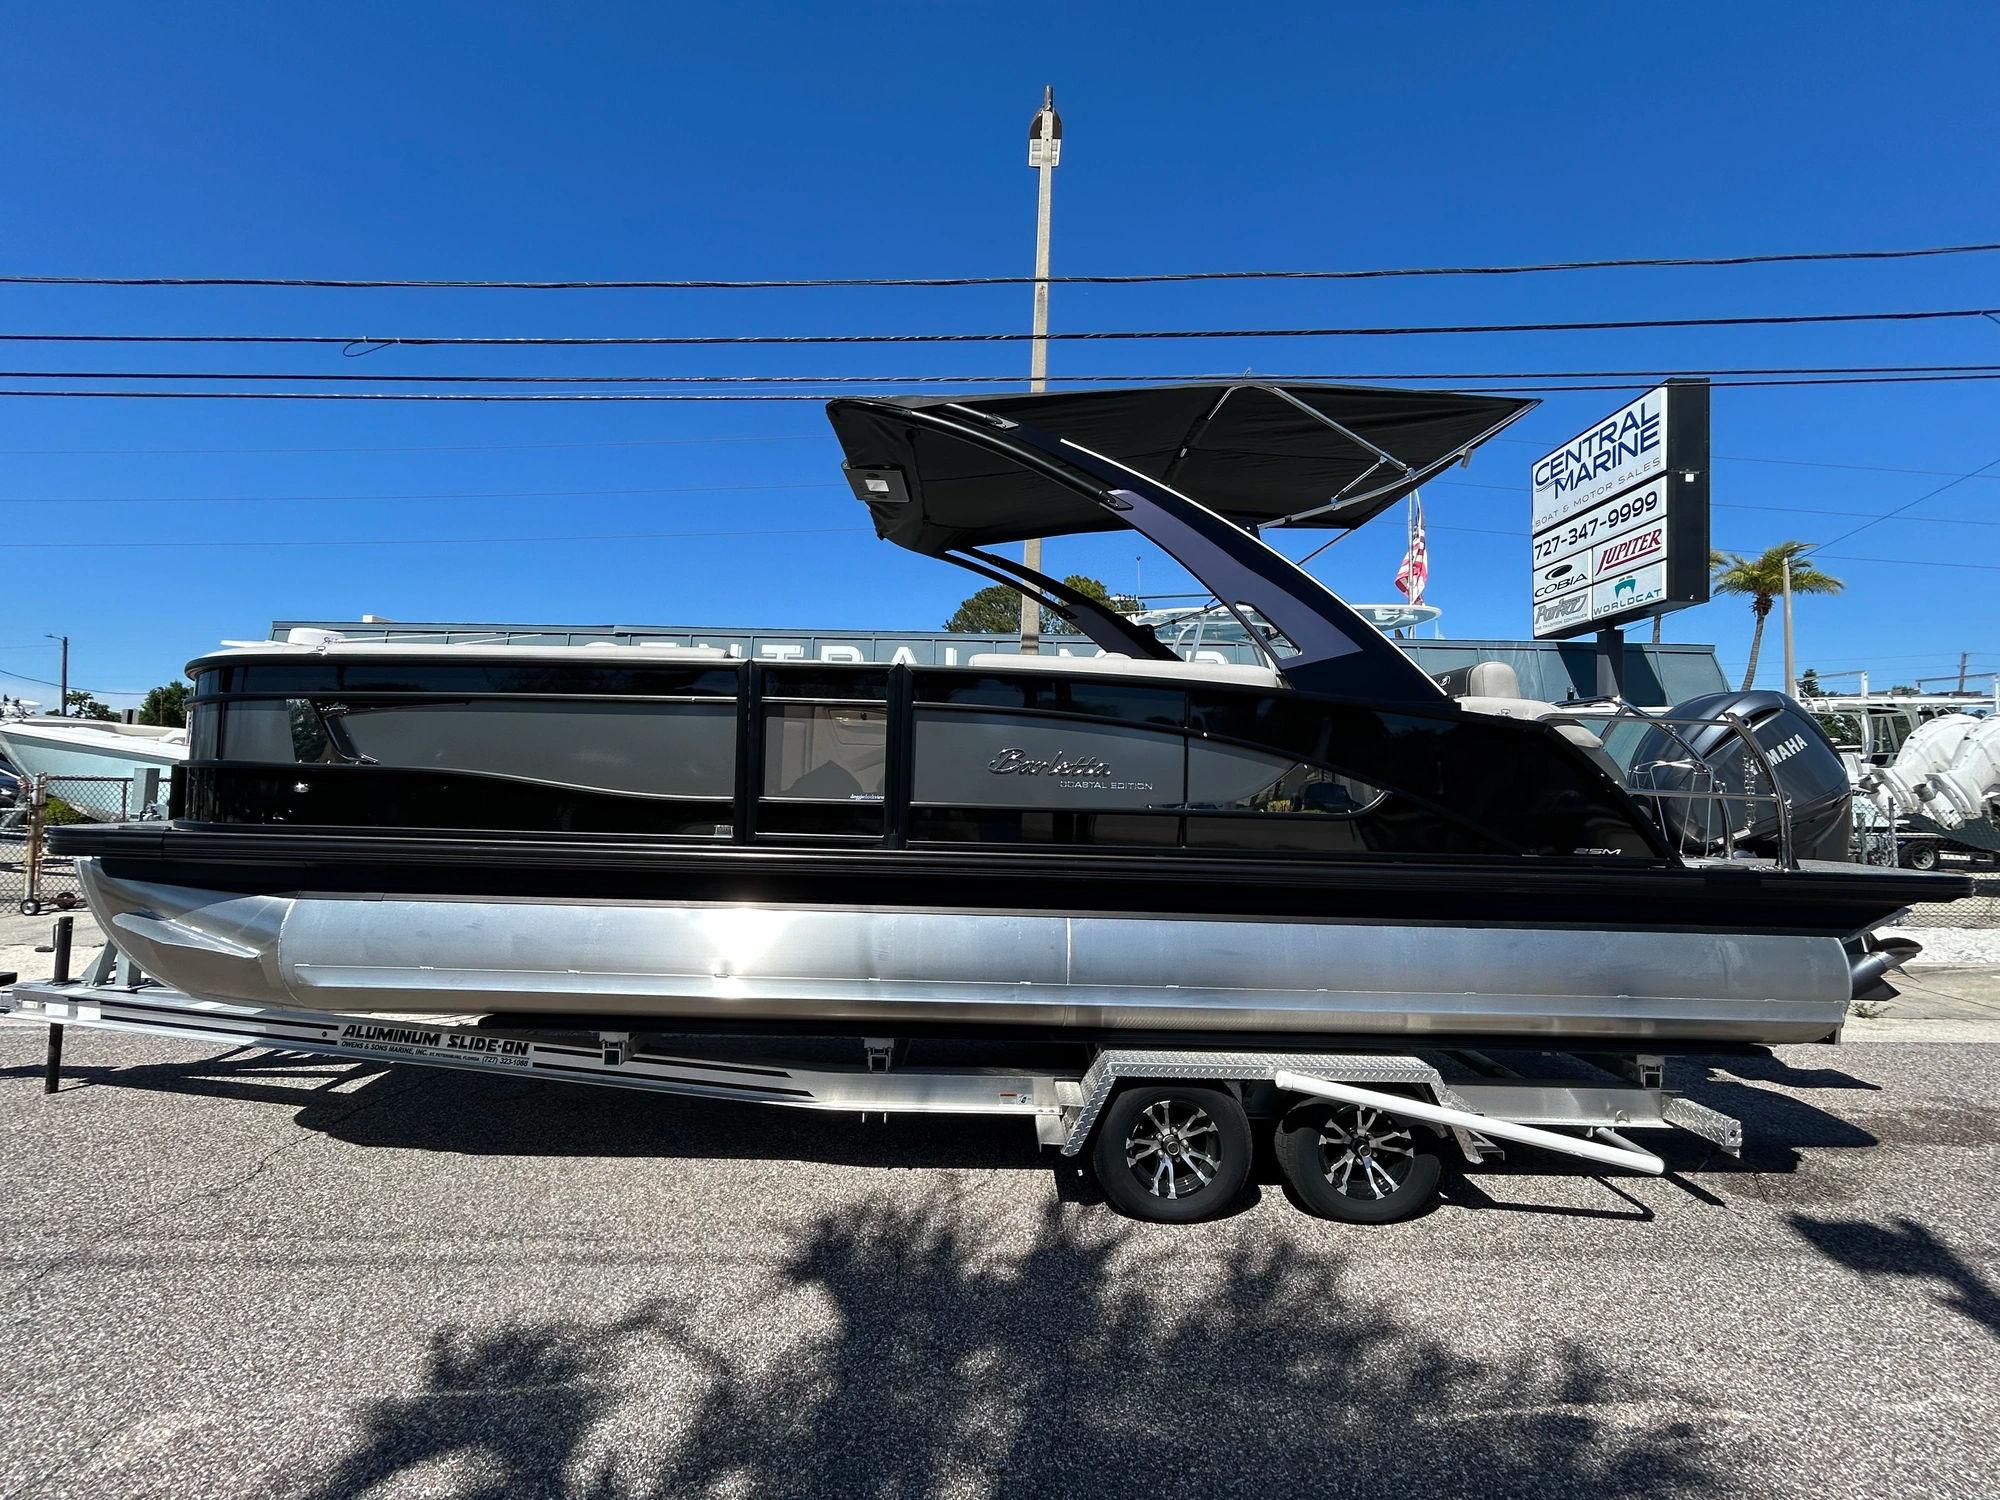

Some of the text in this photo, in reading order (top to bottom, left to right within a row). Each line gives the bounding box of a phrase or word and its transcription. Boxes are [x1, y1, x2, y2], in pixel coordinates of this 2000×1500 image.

[1535, 402, 1660, 486] CENTRAL
[1554, 420, 1660, 500] MARINE
[1535, 457, 1661, 527] BOAT & MOTOR SALES
[1534, 490, 1658, 561] 727-347-9999
[1595, 528, 1662, 576] JUPITER
[1535, 573, 1588, 598] COBIA
[1593, 588, 1662, 616] WORLDCAT
[988, 747, 1112, 778] Barletta
[1761, 733, 1808, 768] MAHA
[1060, 780, 1153, 791] COASTAL EDITION
[341, 1024, 530, 1056] ALUMINUM SLIDE-ON
[341, 1040, 365, 1050] OWENS
[370, 1043, 388, 1052] SONS
[482, 1056, 498, 1065] (727)
